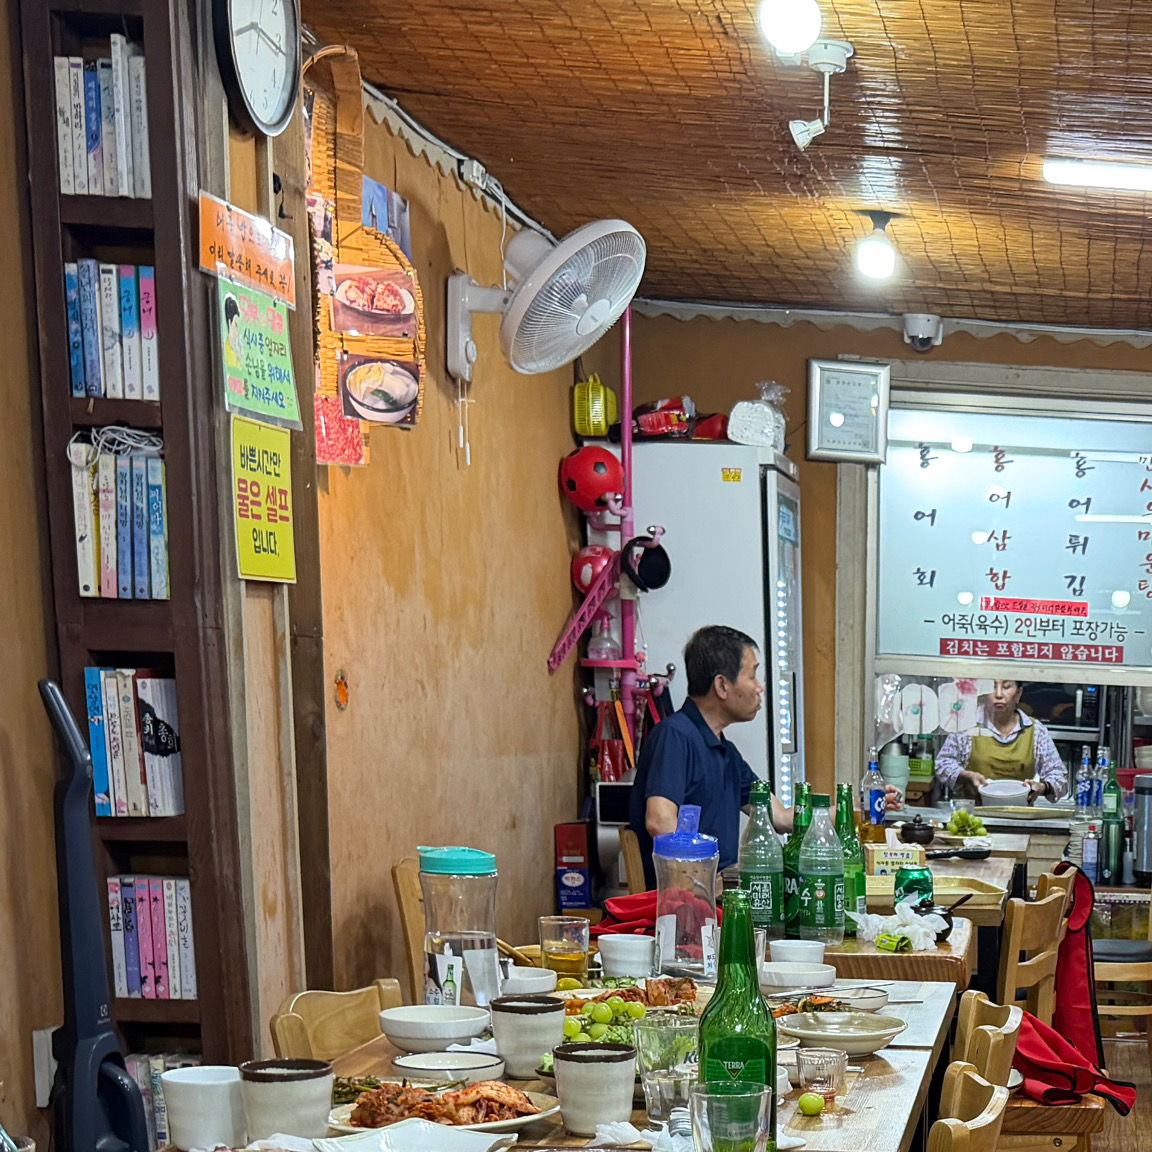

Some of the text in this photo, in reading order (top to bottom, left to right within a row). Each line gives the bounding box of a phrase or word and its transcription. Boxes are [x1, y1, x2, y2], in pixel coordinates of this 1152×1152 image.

[243, 328, 264, 355] 식사중
[245, 353, 291, 385] 손님을 위해서
[251, 384, 285, 408] 지켜주세요
[240, 444, 281, 477] 바쁜시간만
[237, 478, 290, 523] 물은 셀프
[252, 528, 280, 556] 입니다.
[942, 613, 1128, 642] 어죽(육수) 2인부터 포장가능
[946, 640, 1118, 662] 김치는 포함되지 않습니다
[800, 888, 813, 906] 수
[723, 1061, 745, 1069] TERRA
